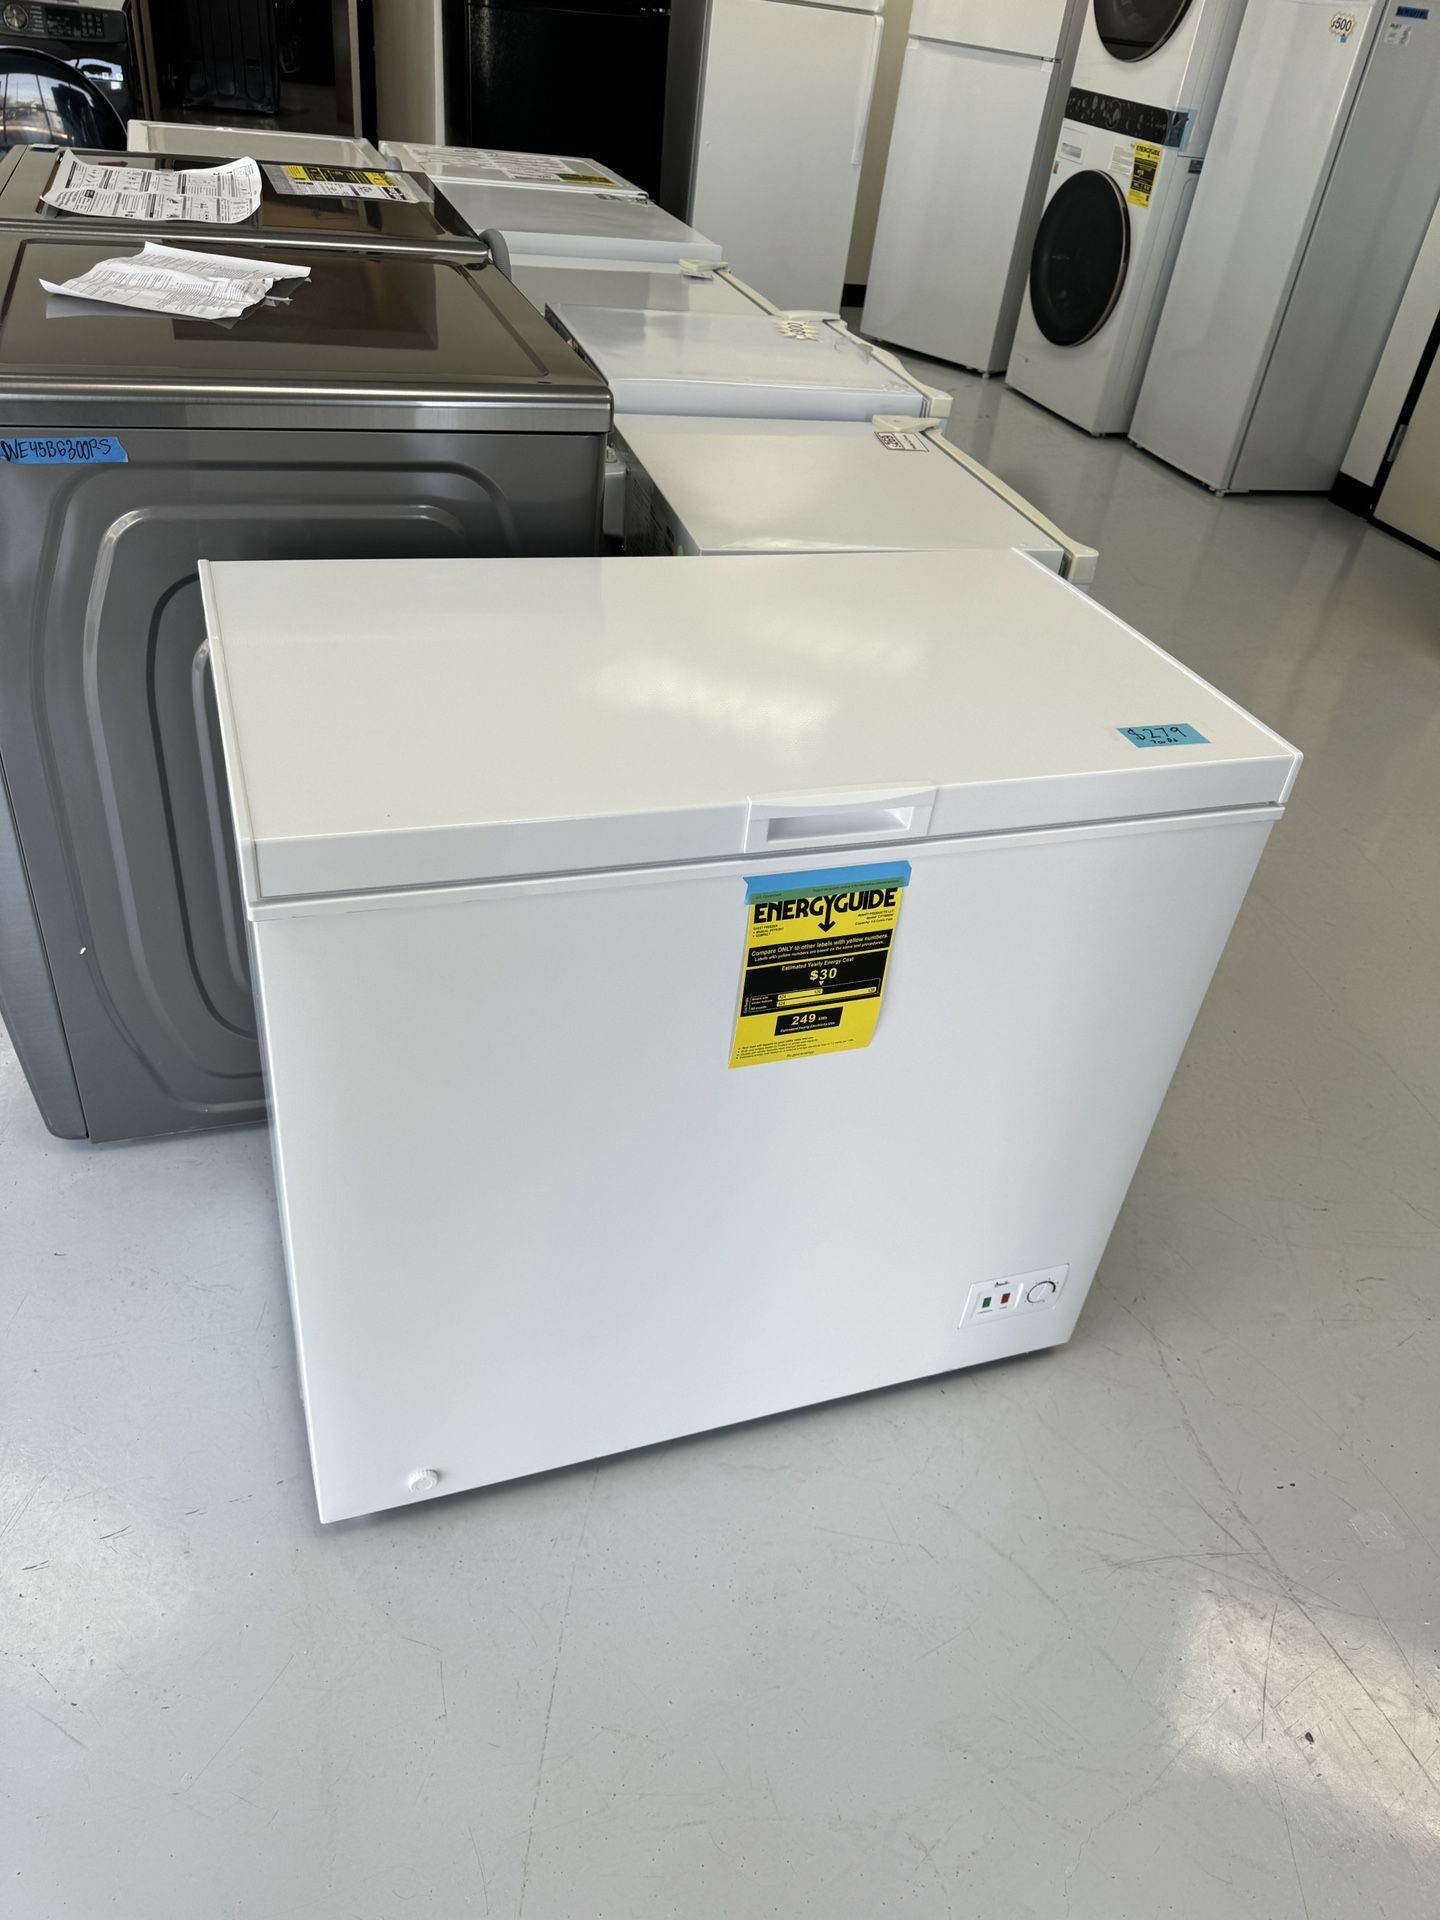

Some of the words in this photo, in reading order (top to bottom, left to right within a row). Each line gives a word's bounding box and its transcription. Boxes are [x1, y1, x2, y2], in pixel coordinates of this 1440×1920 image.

[1331, 18, 1352, 31] $500
[1128, 727, 1186, 740] $279
[754, 888, 898, 924] ENERGYGUIDE
[752, 949, 776, 957] Compare
[810, 968, 837, 980] $30
[792, 1014, 816, 1025] 249
